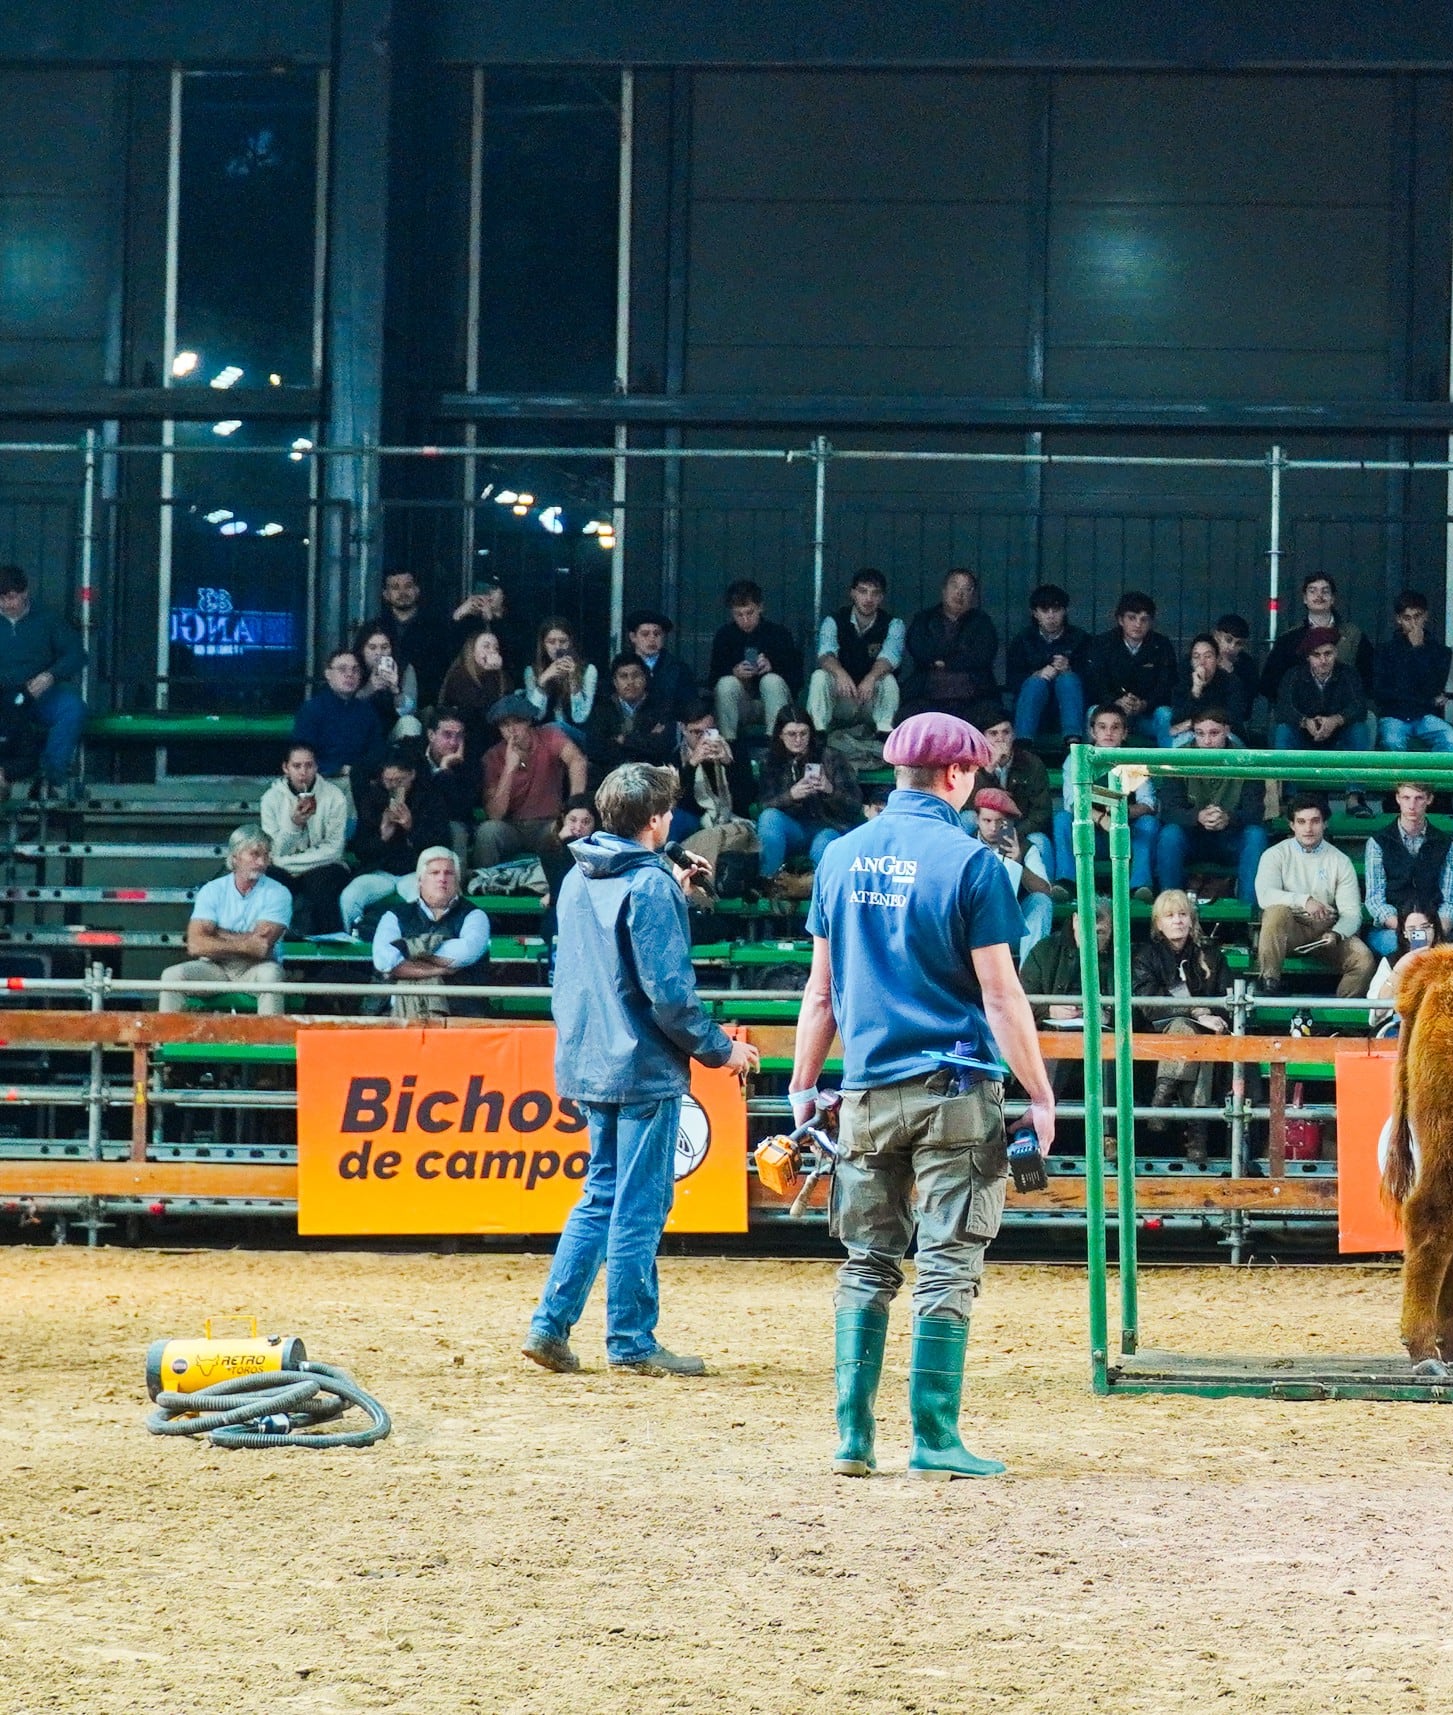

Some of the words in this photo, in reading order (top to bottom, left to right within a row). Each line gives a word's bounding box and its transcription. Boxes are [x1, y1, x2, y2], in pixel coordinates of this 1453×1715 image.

[849, 890, 907, 908] ATENEO
[340, 1074, 589, 1134] Bichos
[338, 1140, 402, 1180] de
[415, 1149, 592, 1191] campo
[221, 1355, 266, 1366] RETRO
